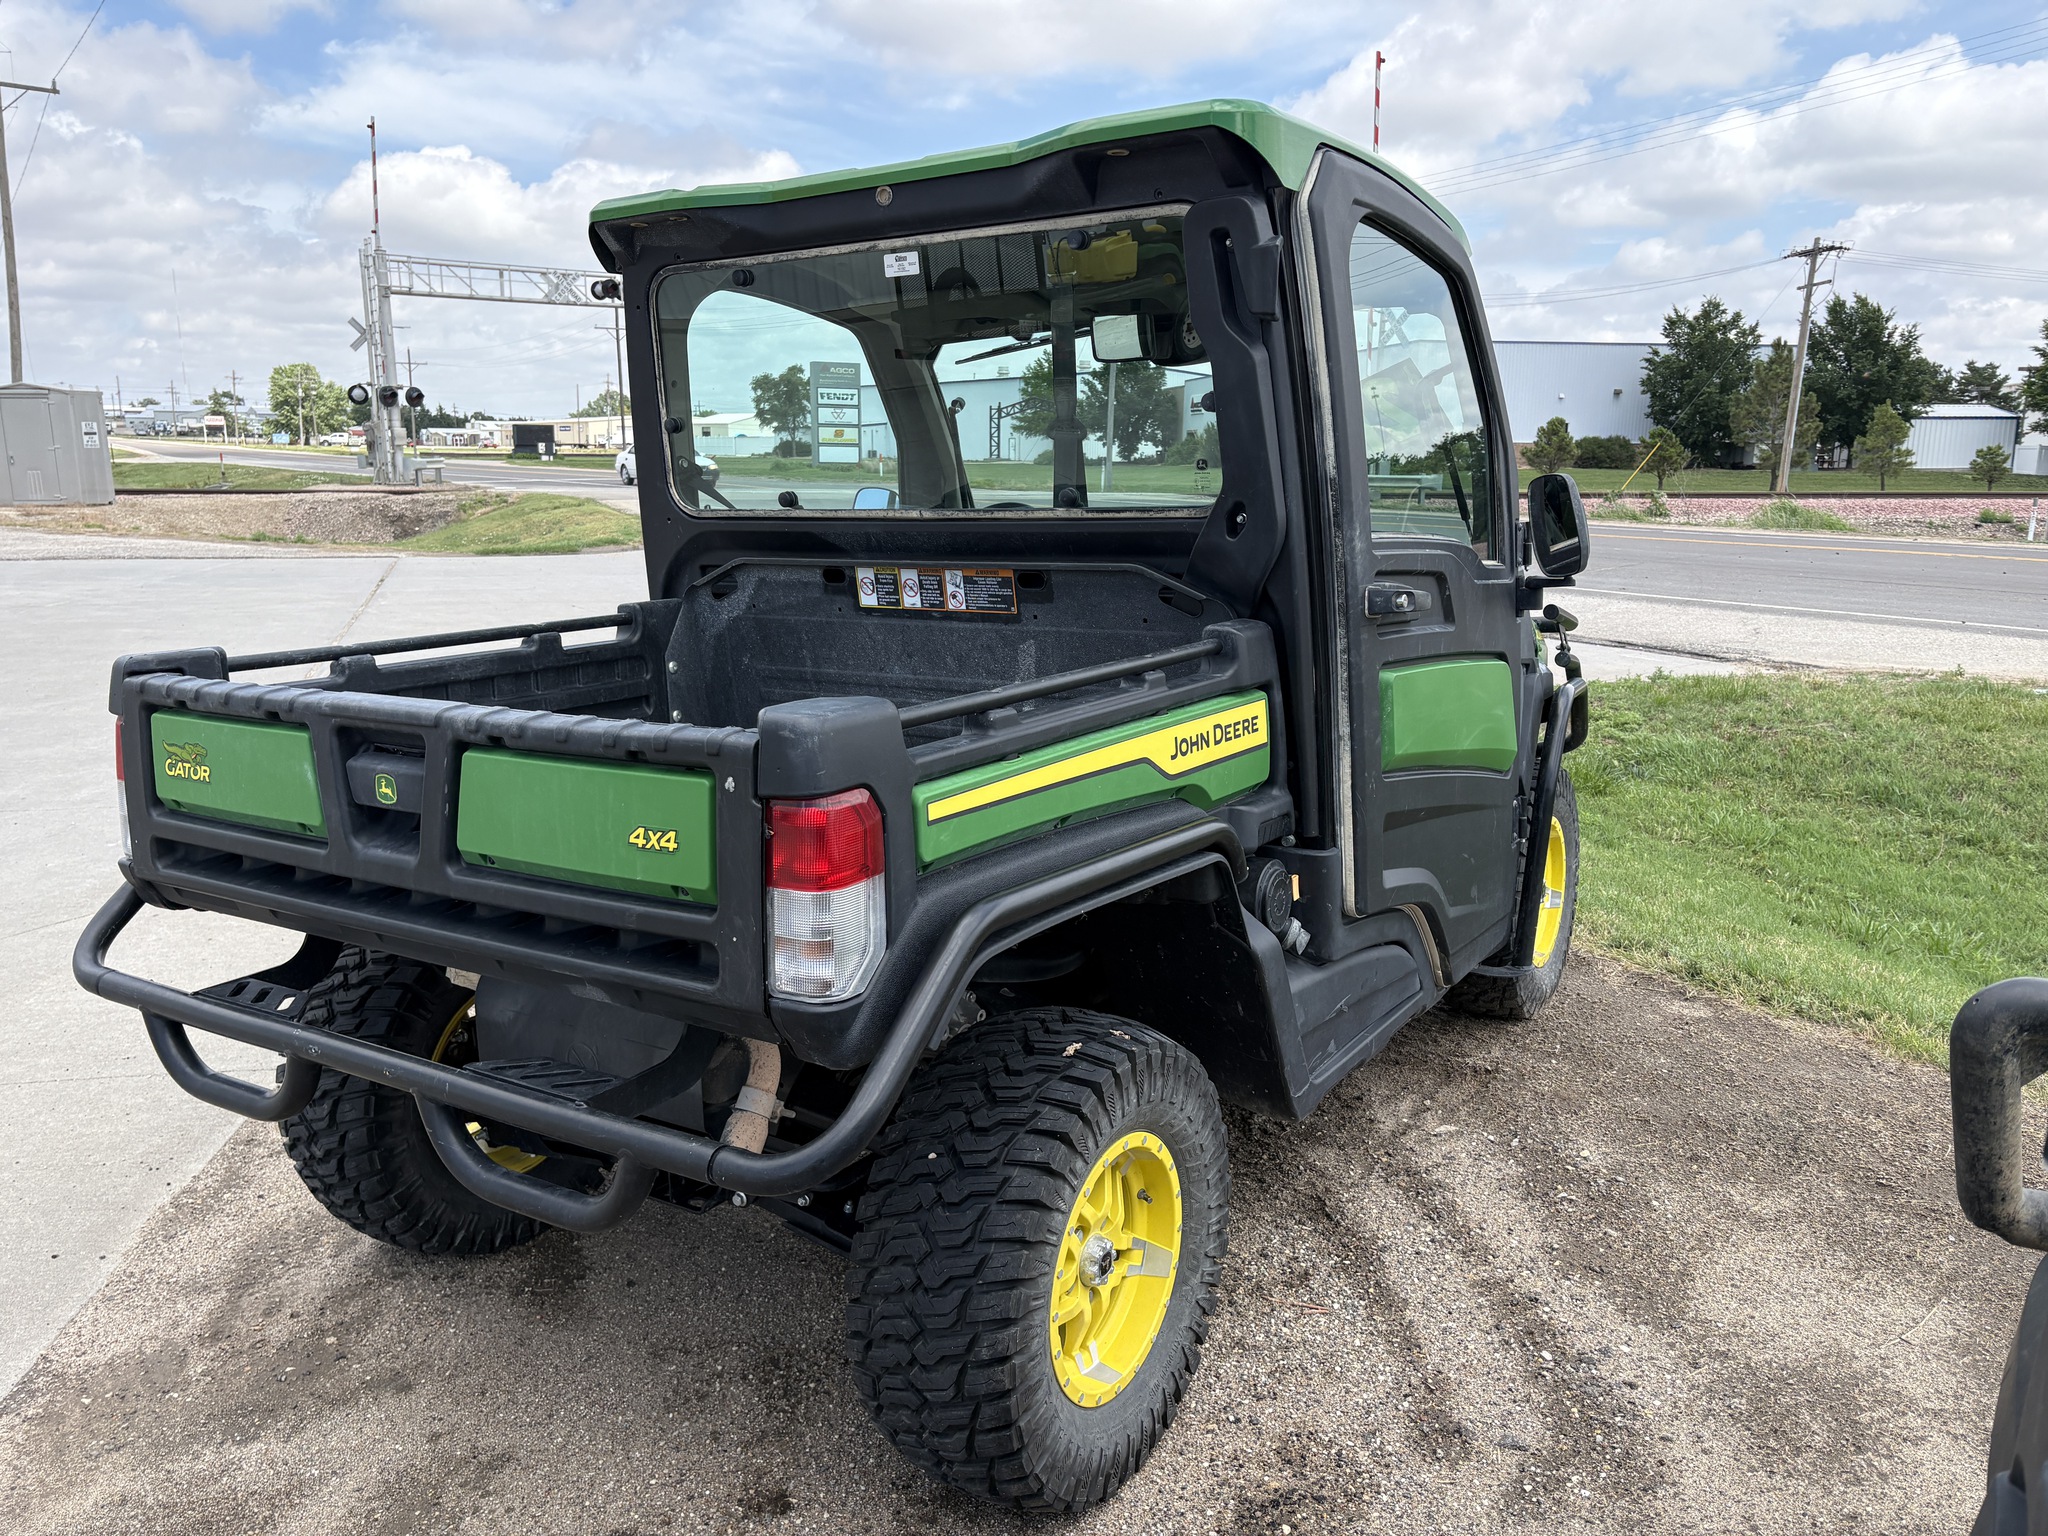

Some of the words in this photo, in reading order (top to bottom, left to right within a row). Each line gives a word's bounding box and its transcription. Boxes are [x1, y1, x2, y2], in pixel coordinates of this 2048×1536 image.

[554, 272, 581, 302] CROSSING
[1382, 311, 1408, 344] CROSSIN
[819, 392, 856, 401] FENDT
[1170, 730, 1210, 761] JOHN
[1213, 715, 1259, 746] DEERE
[165, 758, 210, 783] GATOR
